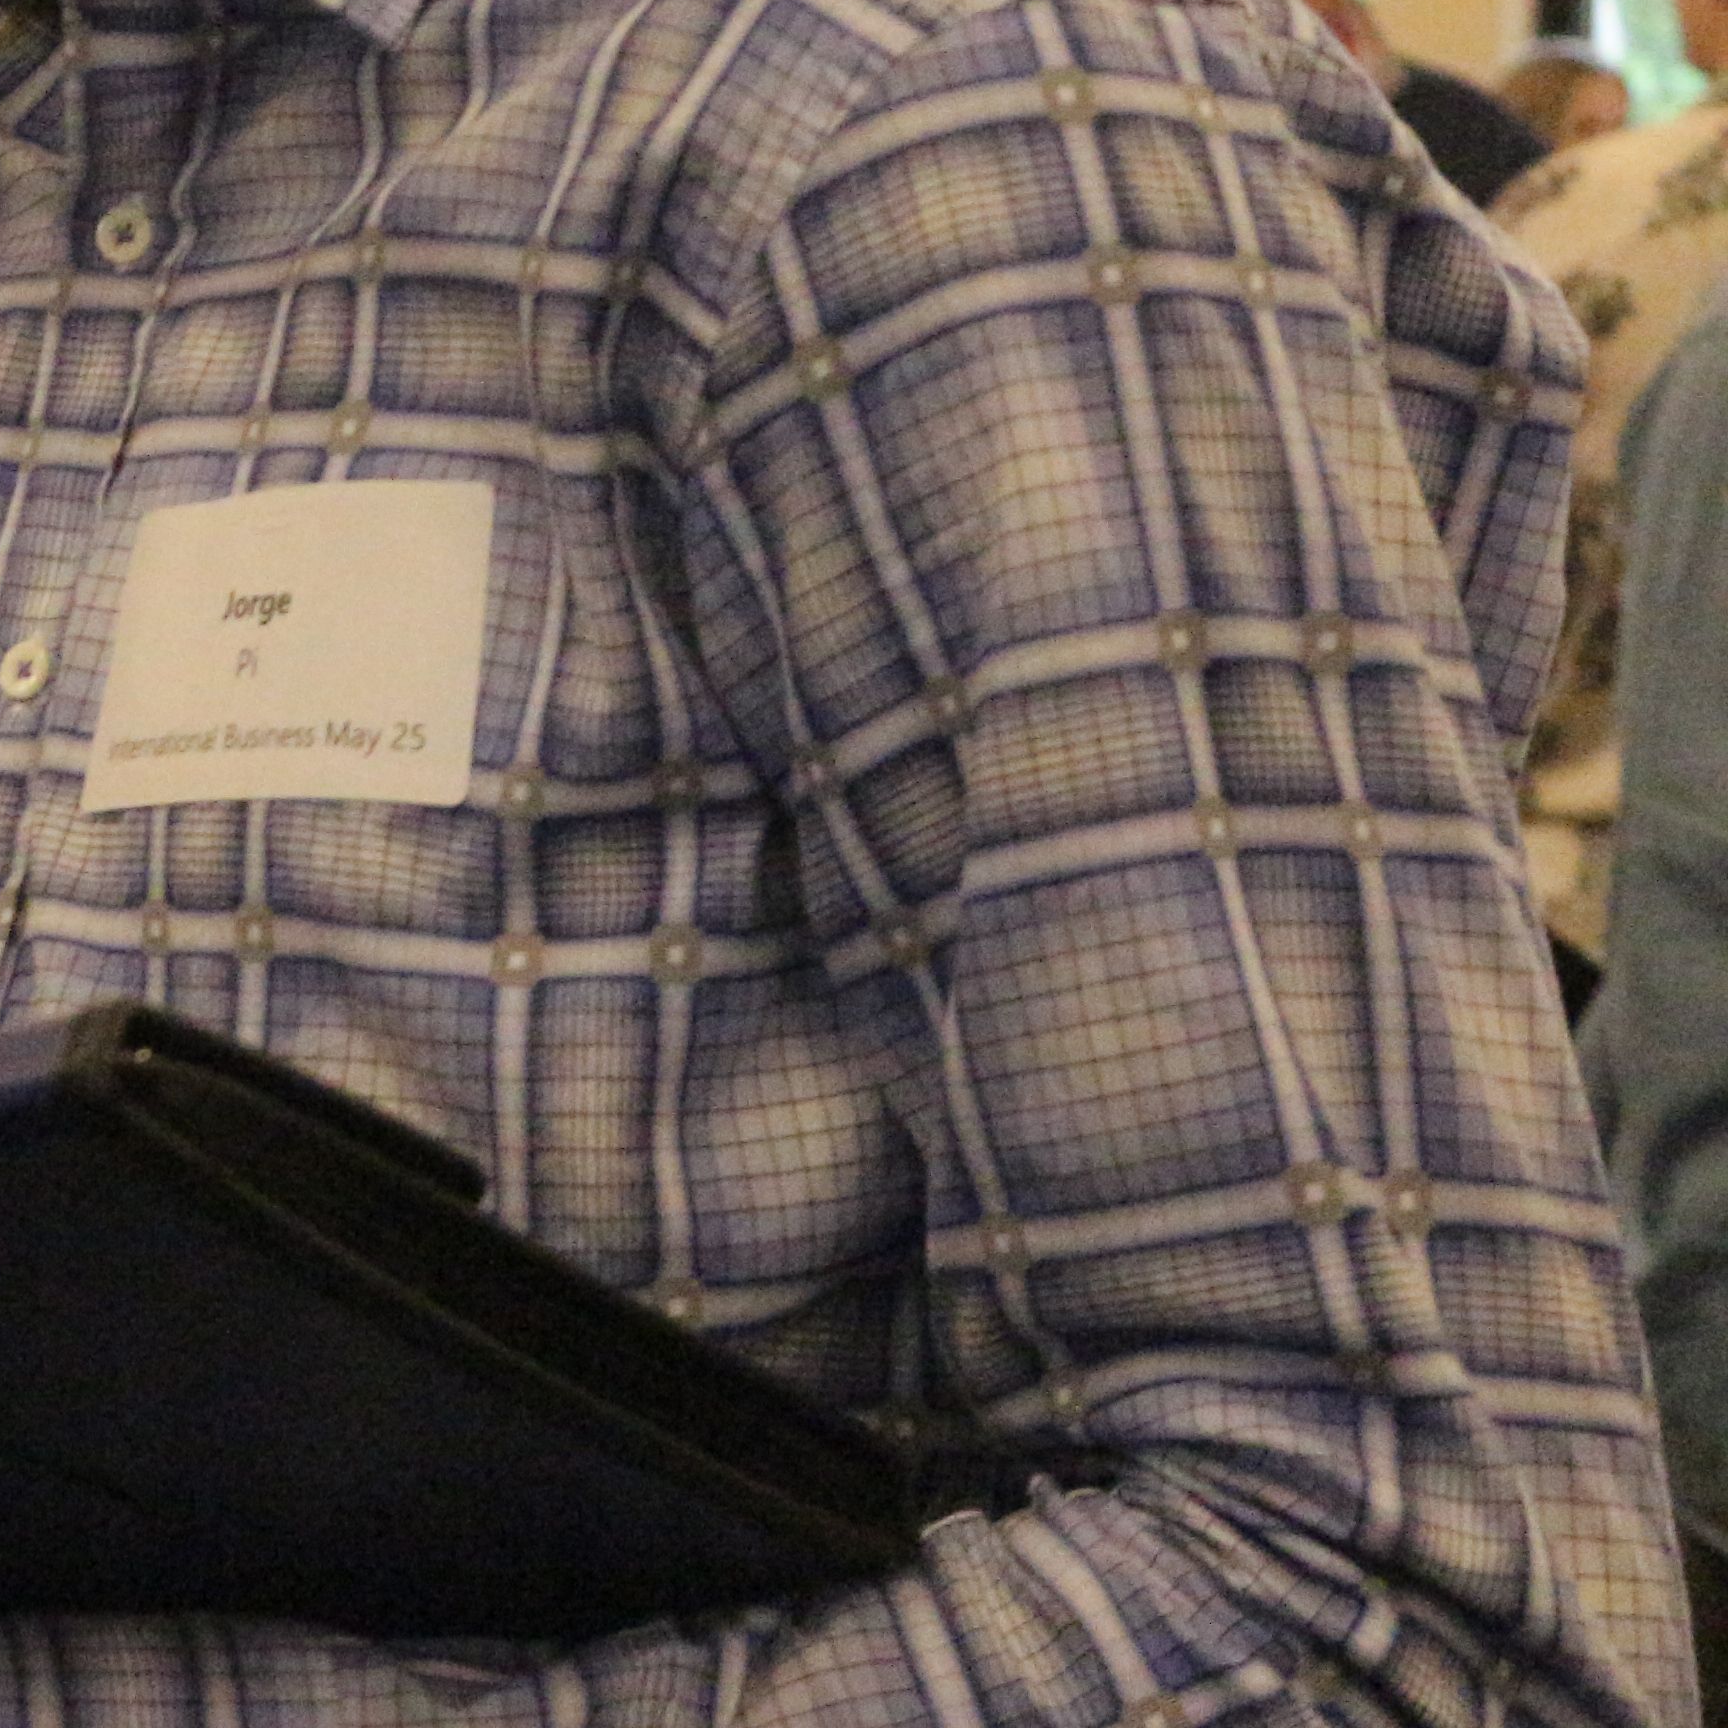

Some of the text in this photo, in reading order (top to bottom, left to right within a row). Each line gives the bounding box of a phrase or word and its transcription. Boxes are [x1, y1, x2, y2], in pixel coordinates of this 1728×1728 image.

[222, 589, 292, 626] Jorge
[221, 722, 317, 750] Business
[325, 719, 384, 759] May
[390, 721, 427, 752] 25
